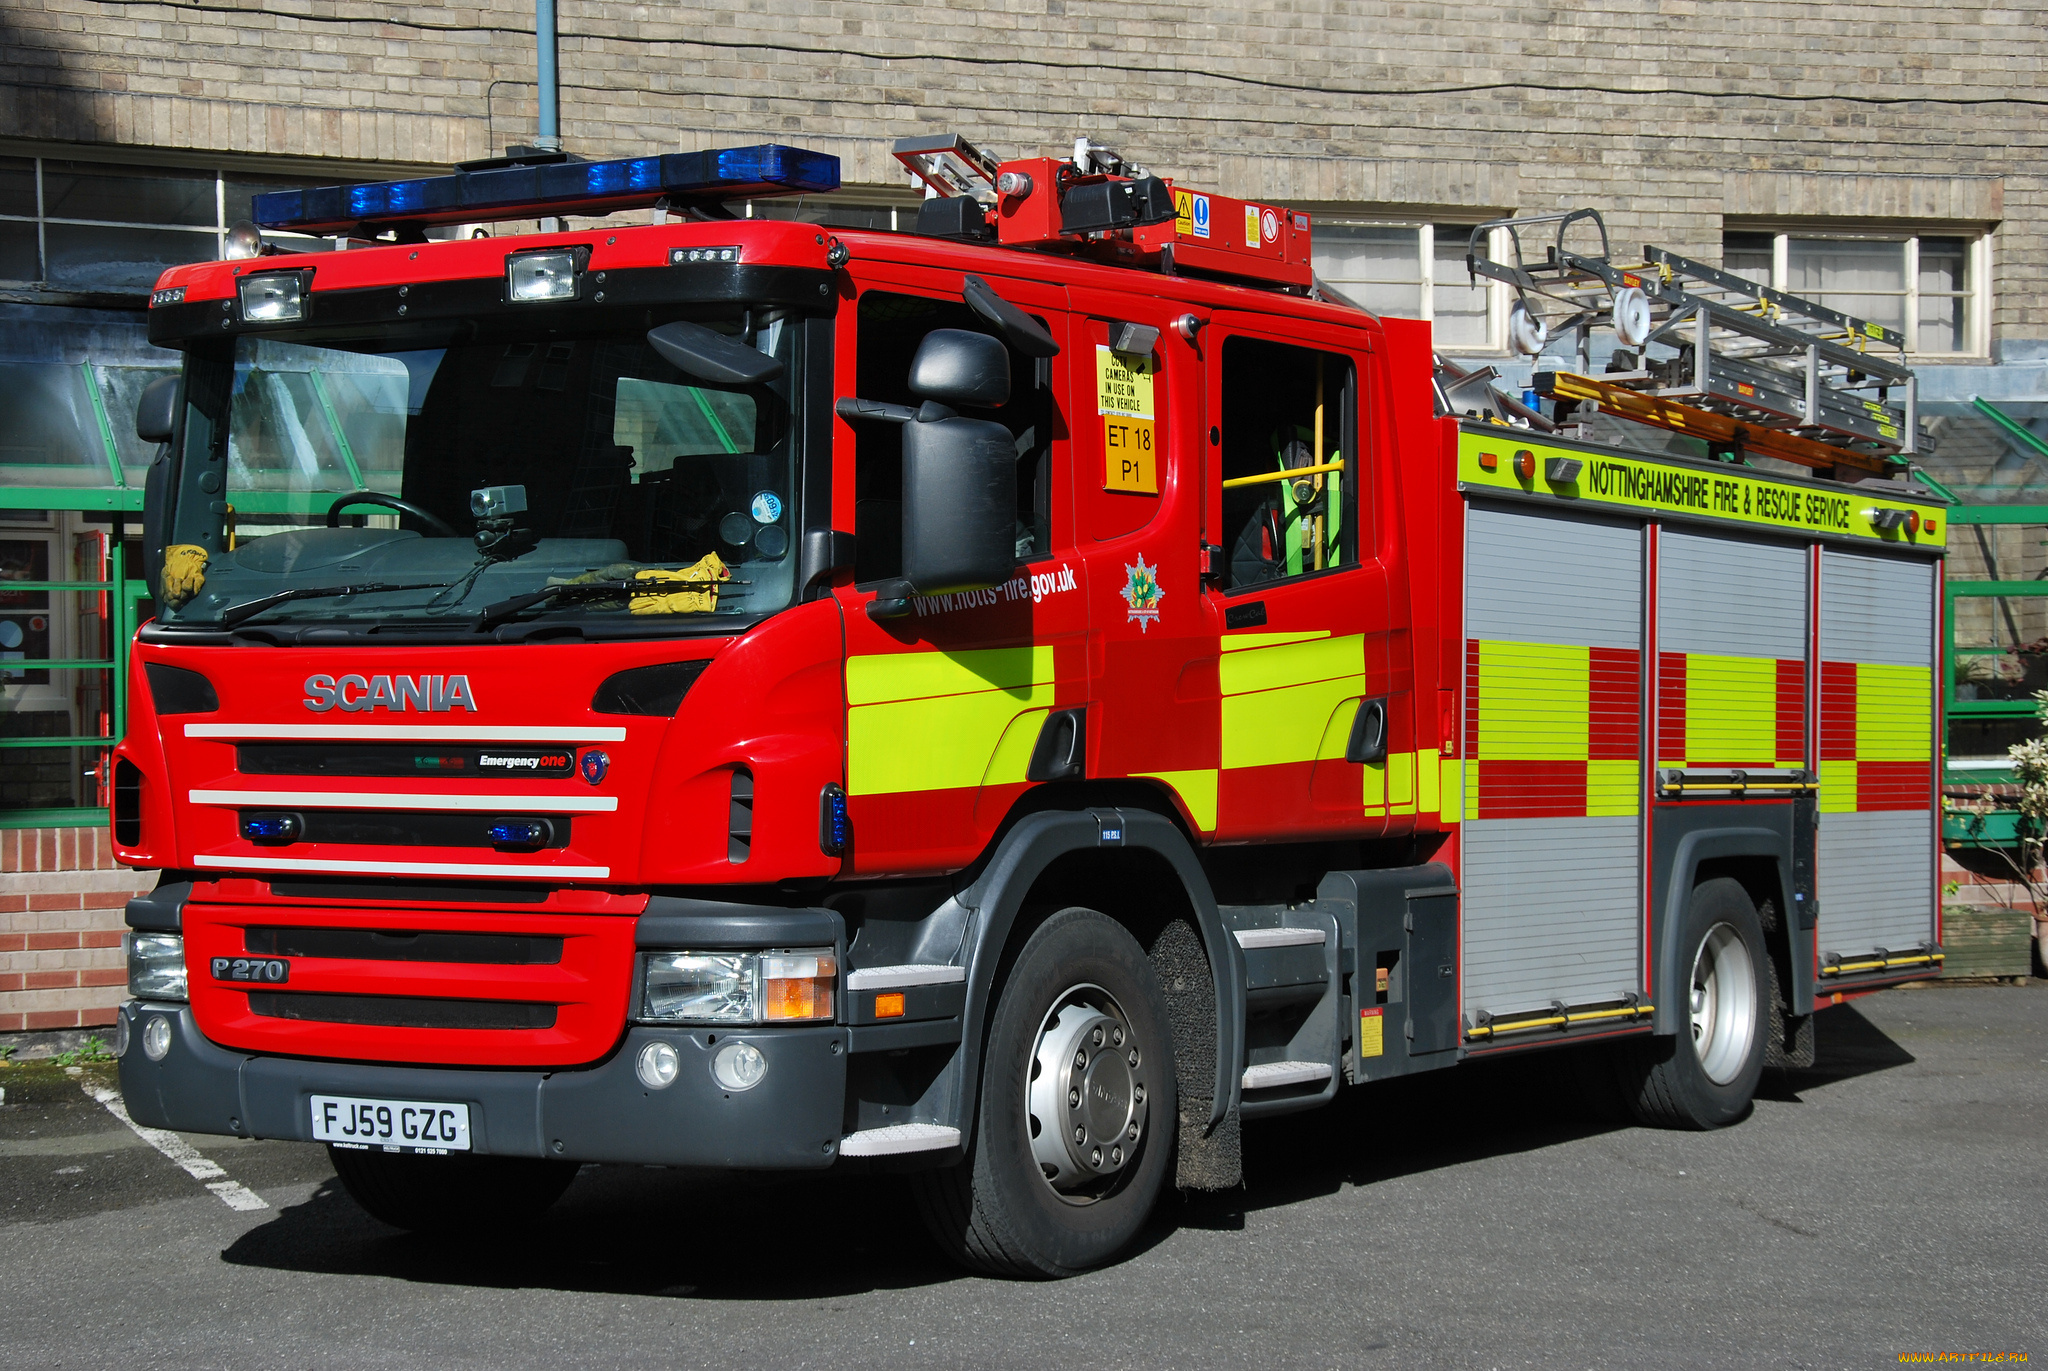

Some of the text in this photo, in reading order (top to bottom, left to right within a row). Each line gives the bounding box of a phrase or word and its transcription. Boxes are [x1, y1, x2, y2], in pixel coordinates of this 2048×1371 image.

[1105, 367, 1134, 383] CAMERAS
[1105, 382, 1135, 397] IN USE ON
[1101, 395, 1141, 412] THIS VEHICLE
[1108, 424, 1151, 451] ET 18
[1121, 459, 1139, 483] P1
[1589, 460, 1850, 529] NOTTINGHAMSHIRE FIRE & RESCUE SERVICE
[302, 673, 478, 713] SCANIA
[479, 754, 566, 769] Emergency one
[212, 958, 283, 981] P 270
[323, 1102, 457, 1143] FJ59 GZG
